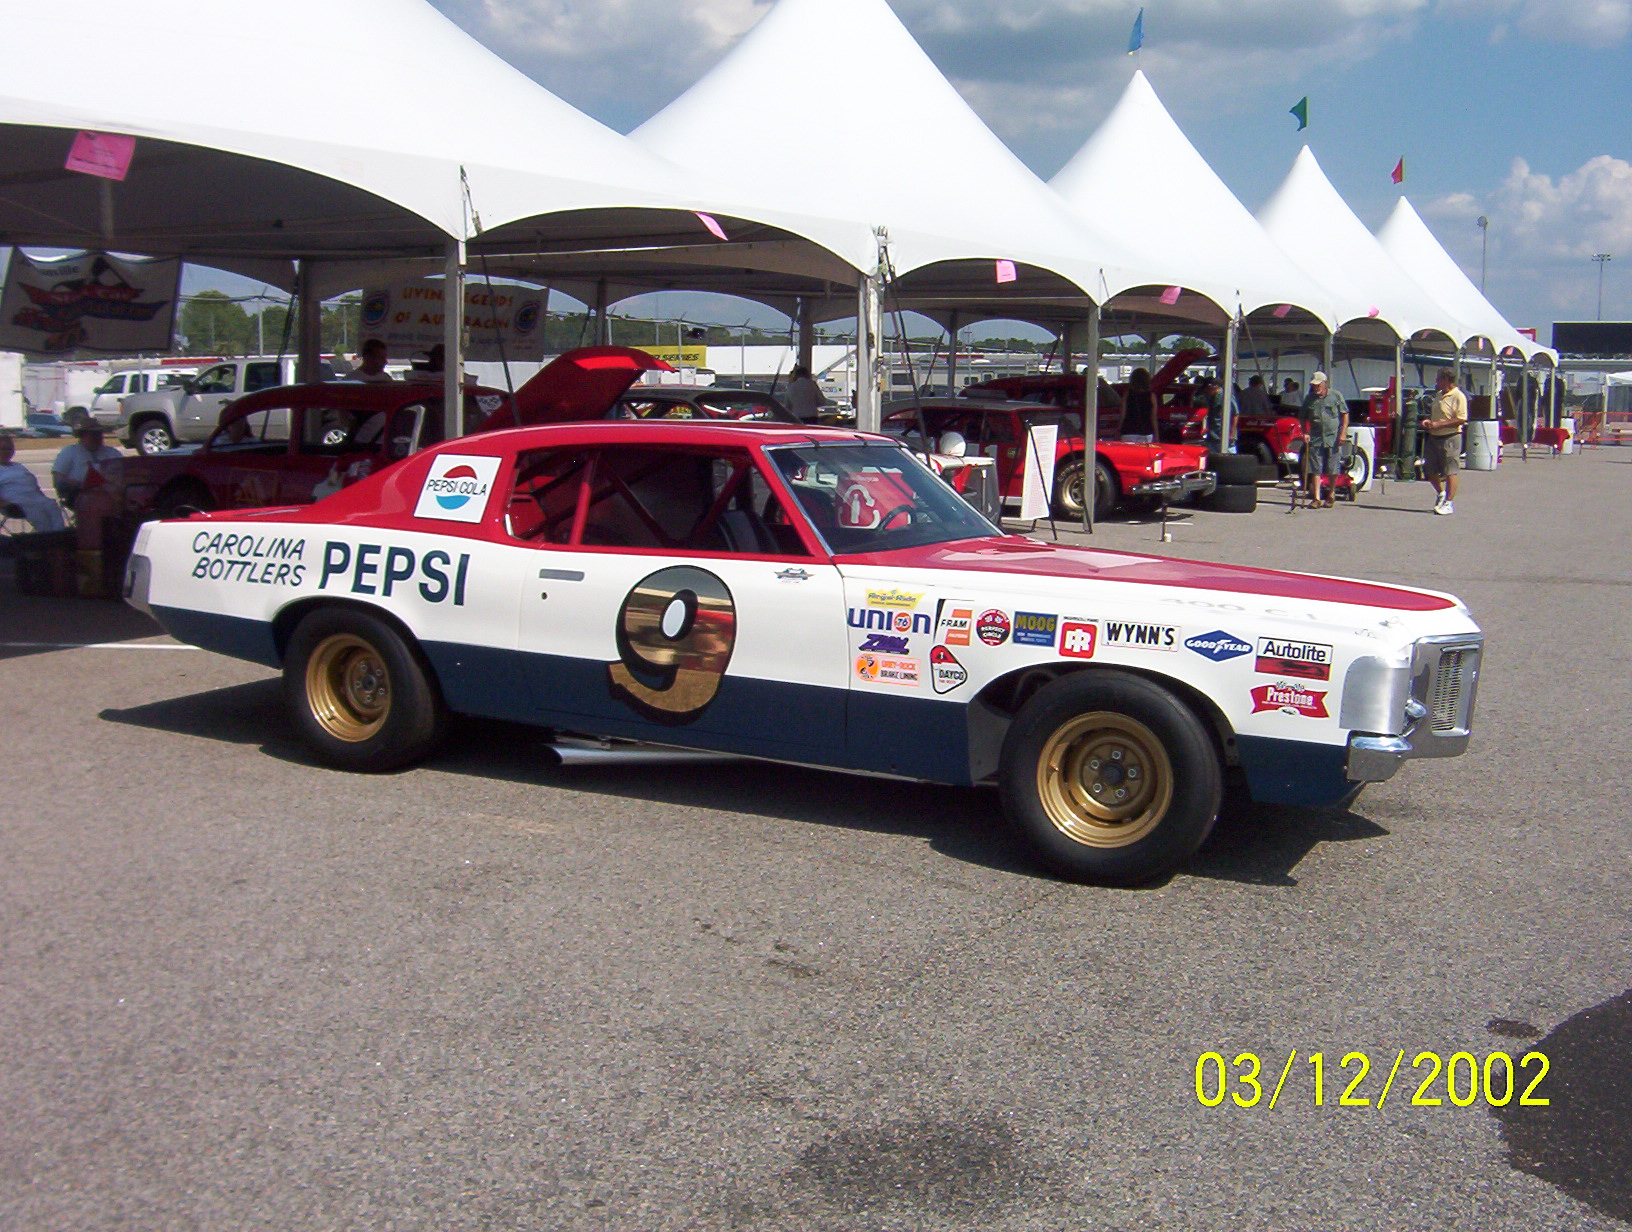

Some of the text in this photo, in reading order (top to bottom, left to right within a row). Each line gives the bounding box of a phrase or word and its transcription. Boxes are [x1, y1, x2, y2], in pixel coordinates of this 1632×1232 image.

[402, 287, 446, 302] LIVIN
[192, 531, 306, 560] CAROLINA
[192, 557, 306, 587] BOTTLERS
[318, 541, 471, 606] PEPSI
[940, 619, 968, 629] FRAM
[1014, 614, 1057, 633] MOOG
[1106, 622, 1176, 646] WYNN'S
[608, 565, 737, 720] 9
[1263, 641, 1327, 662] Autolite
[939, 669, 964, 681] DAYCO
[1266, 686, 1314, 706] Prestone
